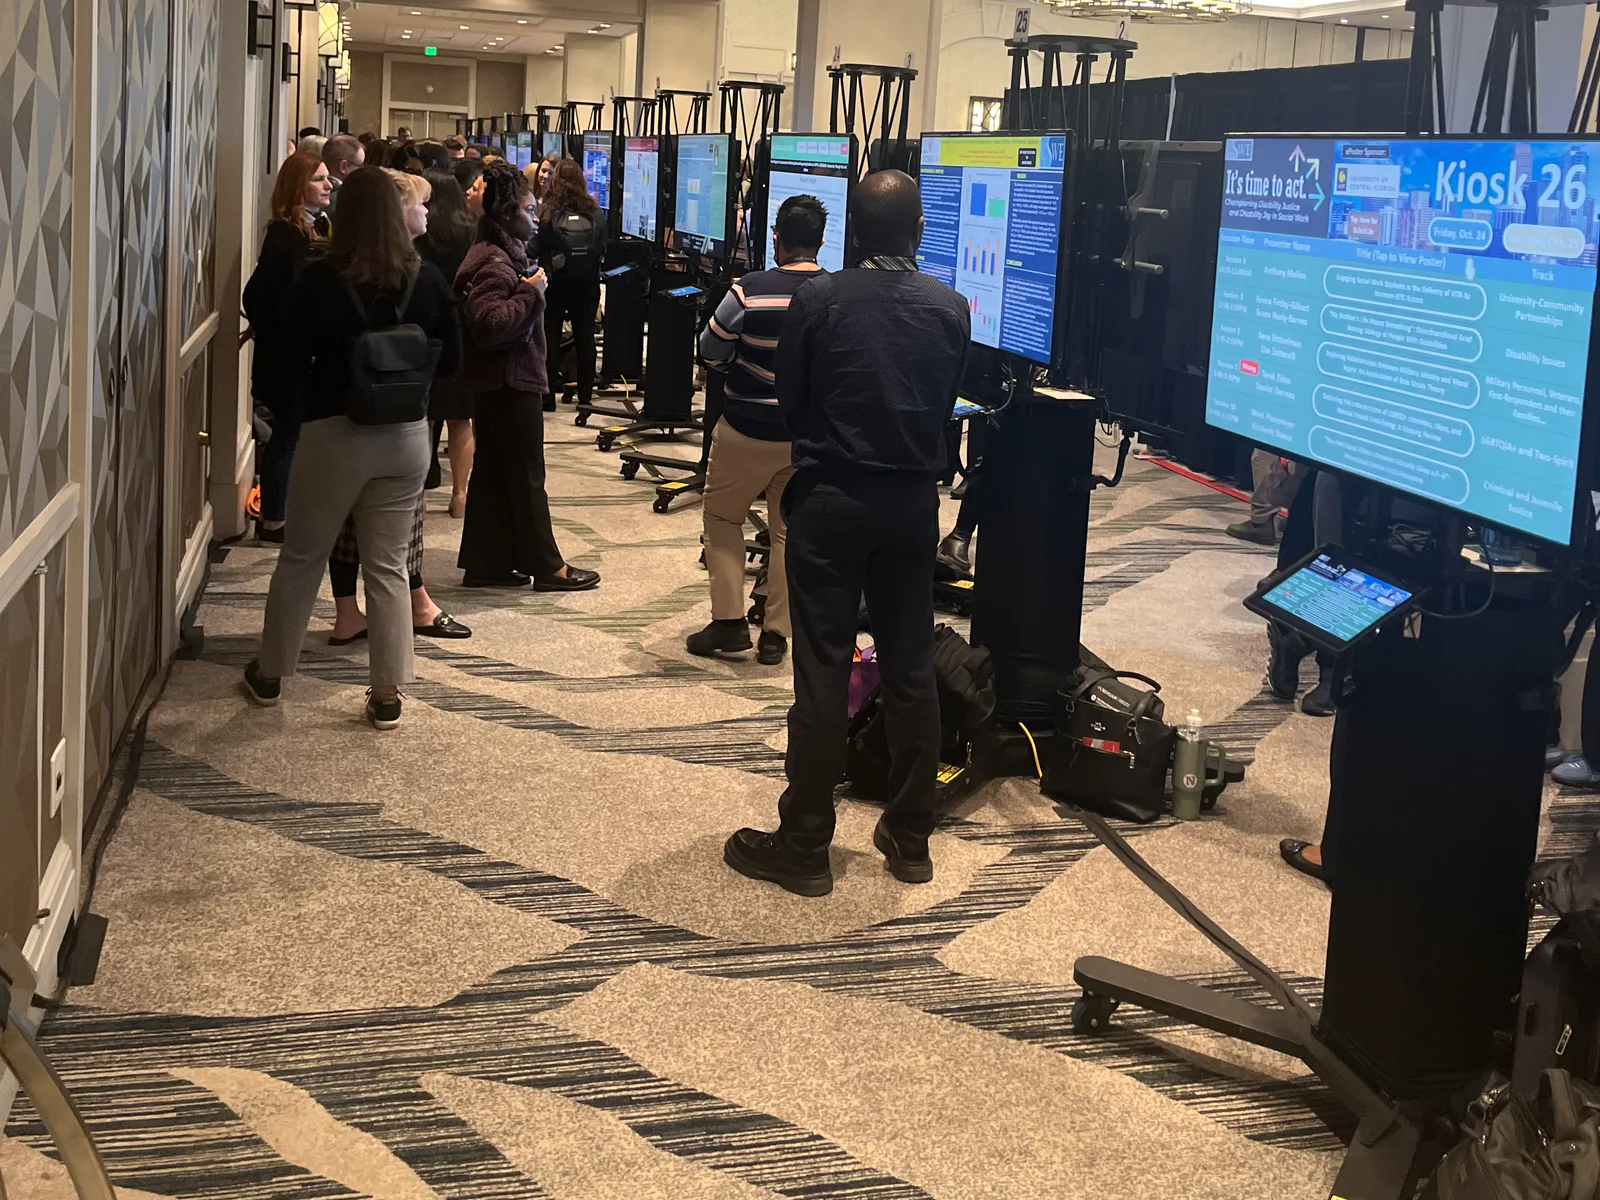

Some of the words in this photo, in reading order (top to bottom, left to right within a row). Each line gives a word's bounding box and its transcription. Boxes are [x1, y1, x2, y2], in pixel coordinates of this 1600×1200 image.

[1016, 11, 1028, 33] 25
[1225, 169, 1244, 195] It's
[1245, 170, 1270, 197] time
[1272, 174, 1283, 197] to
[1285, 175, 1306, 199] act.
[1435, 160, 1528, 210] Kiosk
[1538, 163, 1587, 210] 26
[1225, 199, 1258, 209] Championing
[1258, 201, 1281, 211] Disability
[1282, 202, 1300, 211] Justice
[1229, 209, 1239, 217] and
[1240, 210, 1262, 220] Disability
[1262, 211, 1272, 221] Joy
[1278, 212, 1294, 222] Social
[1294, 214, 1310, 223] Work
[1434, 226, 1458, 240] Friday,
[1459, 229, 1474, 240] Oct.
[1476, 230, 1486, 240] 24
[1264, 238, 1292, 249] Presenter
[1293, 240, 1311, 252] Name
[1356, 248, 1372, 259] Title
[1389, 252, 1398, 262] to
[1399, 253, 1418, 265] View
[1418, 255, 1446, 270] Poster)
[1532, 269, 1554, 282] Track
[1500, 292, 1585, 316] University-Community
[1515, 310, 1564, 328] Partnerships
[1506, 348, 1541, 364] Disability
[1542, 355, 1566, 368] Issues
[1486, 376, 1512, 391] Military
[1512, 382, 1547, 398] Personnel,
[1488, 390, 1543, 410] First-Responders
[1544, 404, 1558, 414] and
[1559, 407, 1577, 418] their
[1481, 436, 1517, 452] LGBTQIA+
[1518, 447, 1533, 458] and
[1535, 450, 1574, 469] Two-Spirit
[1484, 480, 1514, 497] Criminal
[1516, 492, 1530, 502] and
[1530, 495, 1564, 513] Juvenile
[1508, 503, 1533, 519] Justice
[1185, 776, 1196, 786] N
